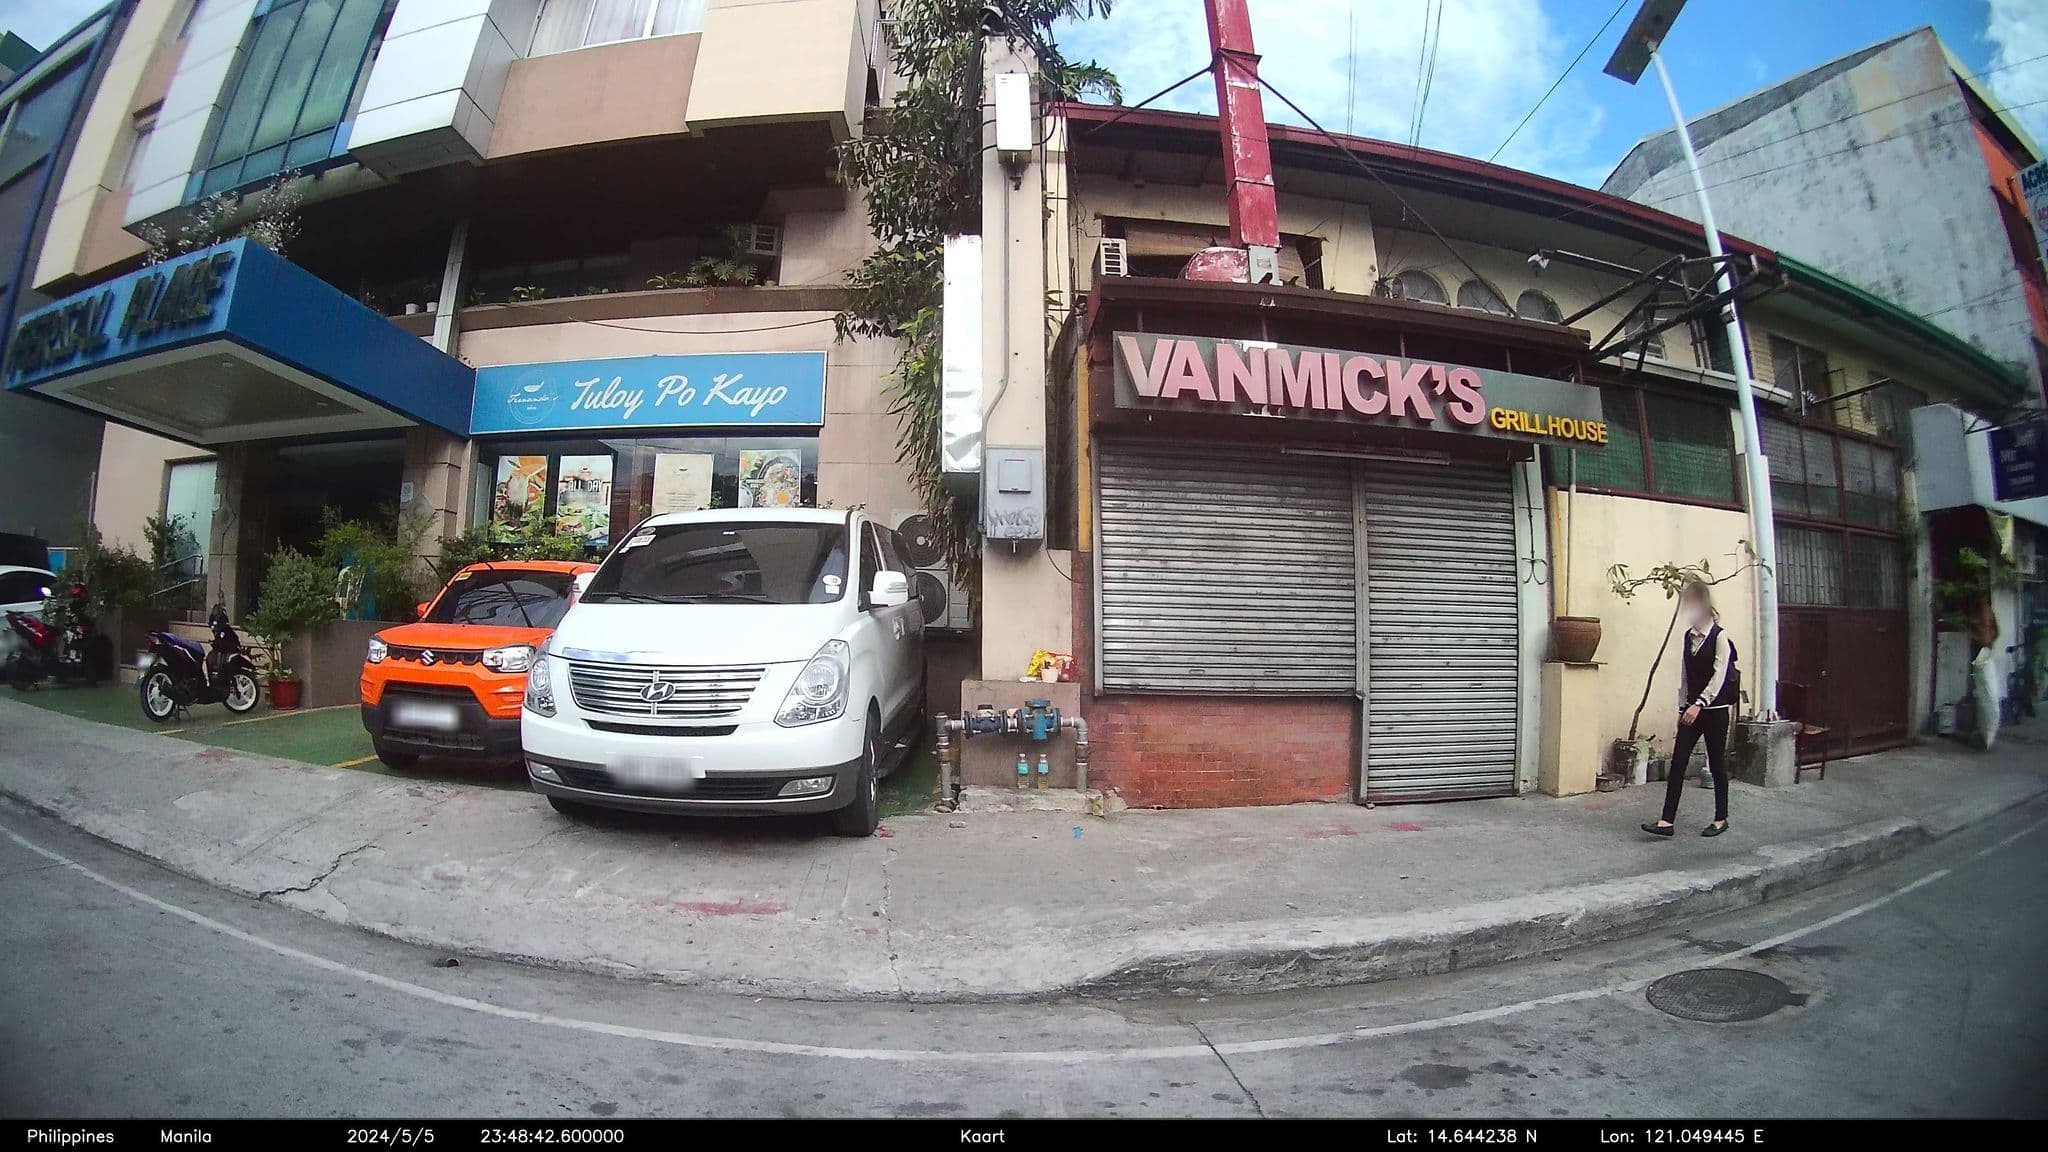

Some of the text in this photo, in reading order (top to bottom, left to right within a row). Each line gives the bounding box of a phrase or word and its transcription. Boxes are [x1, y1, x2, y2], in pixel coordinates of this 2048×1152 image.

[118, 250, 235, 342] PLACE
[571, 373, 788, 419] Tuloy Po Kayo
[1118, 335, 1486, 425] VANMICK'S
[568, 480, 604, 493] ALL DAY
